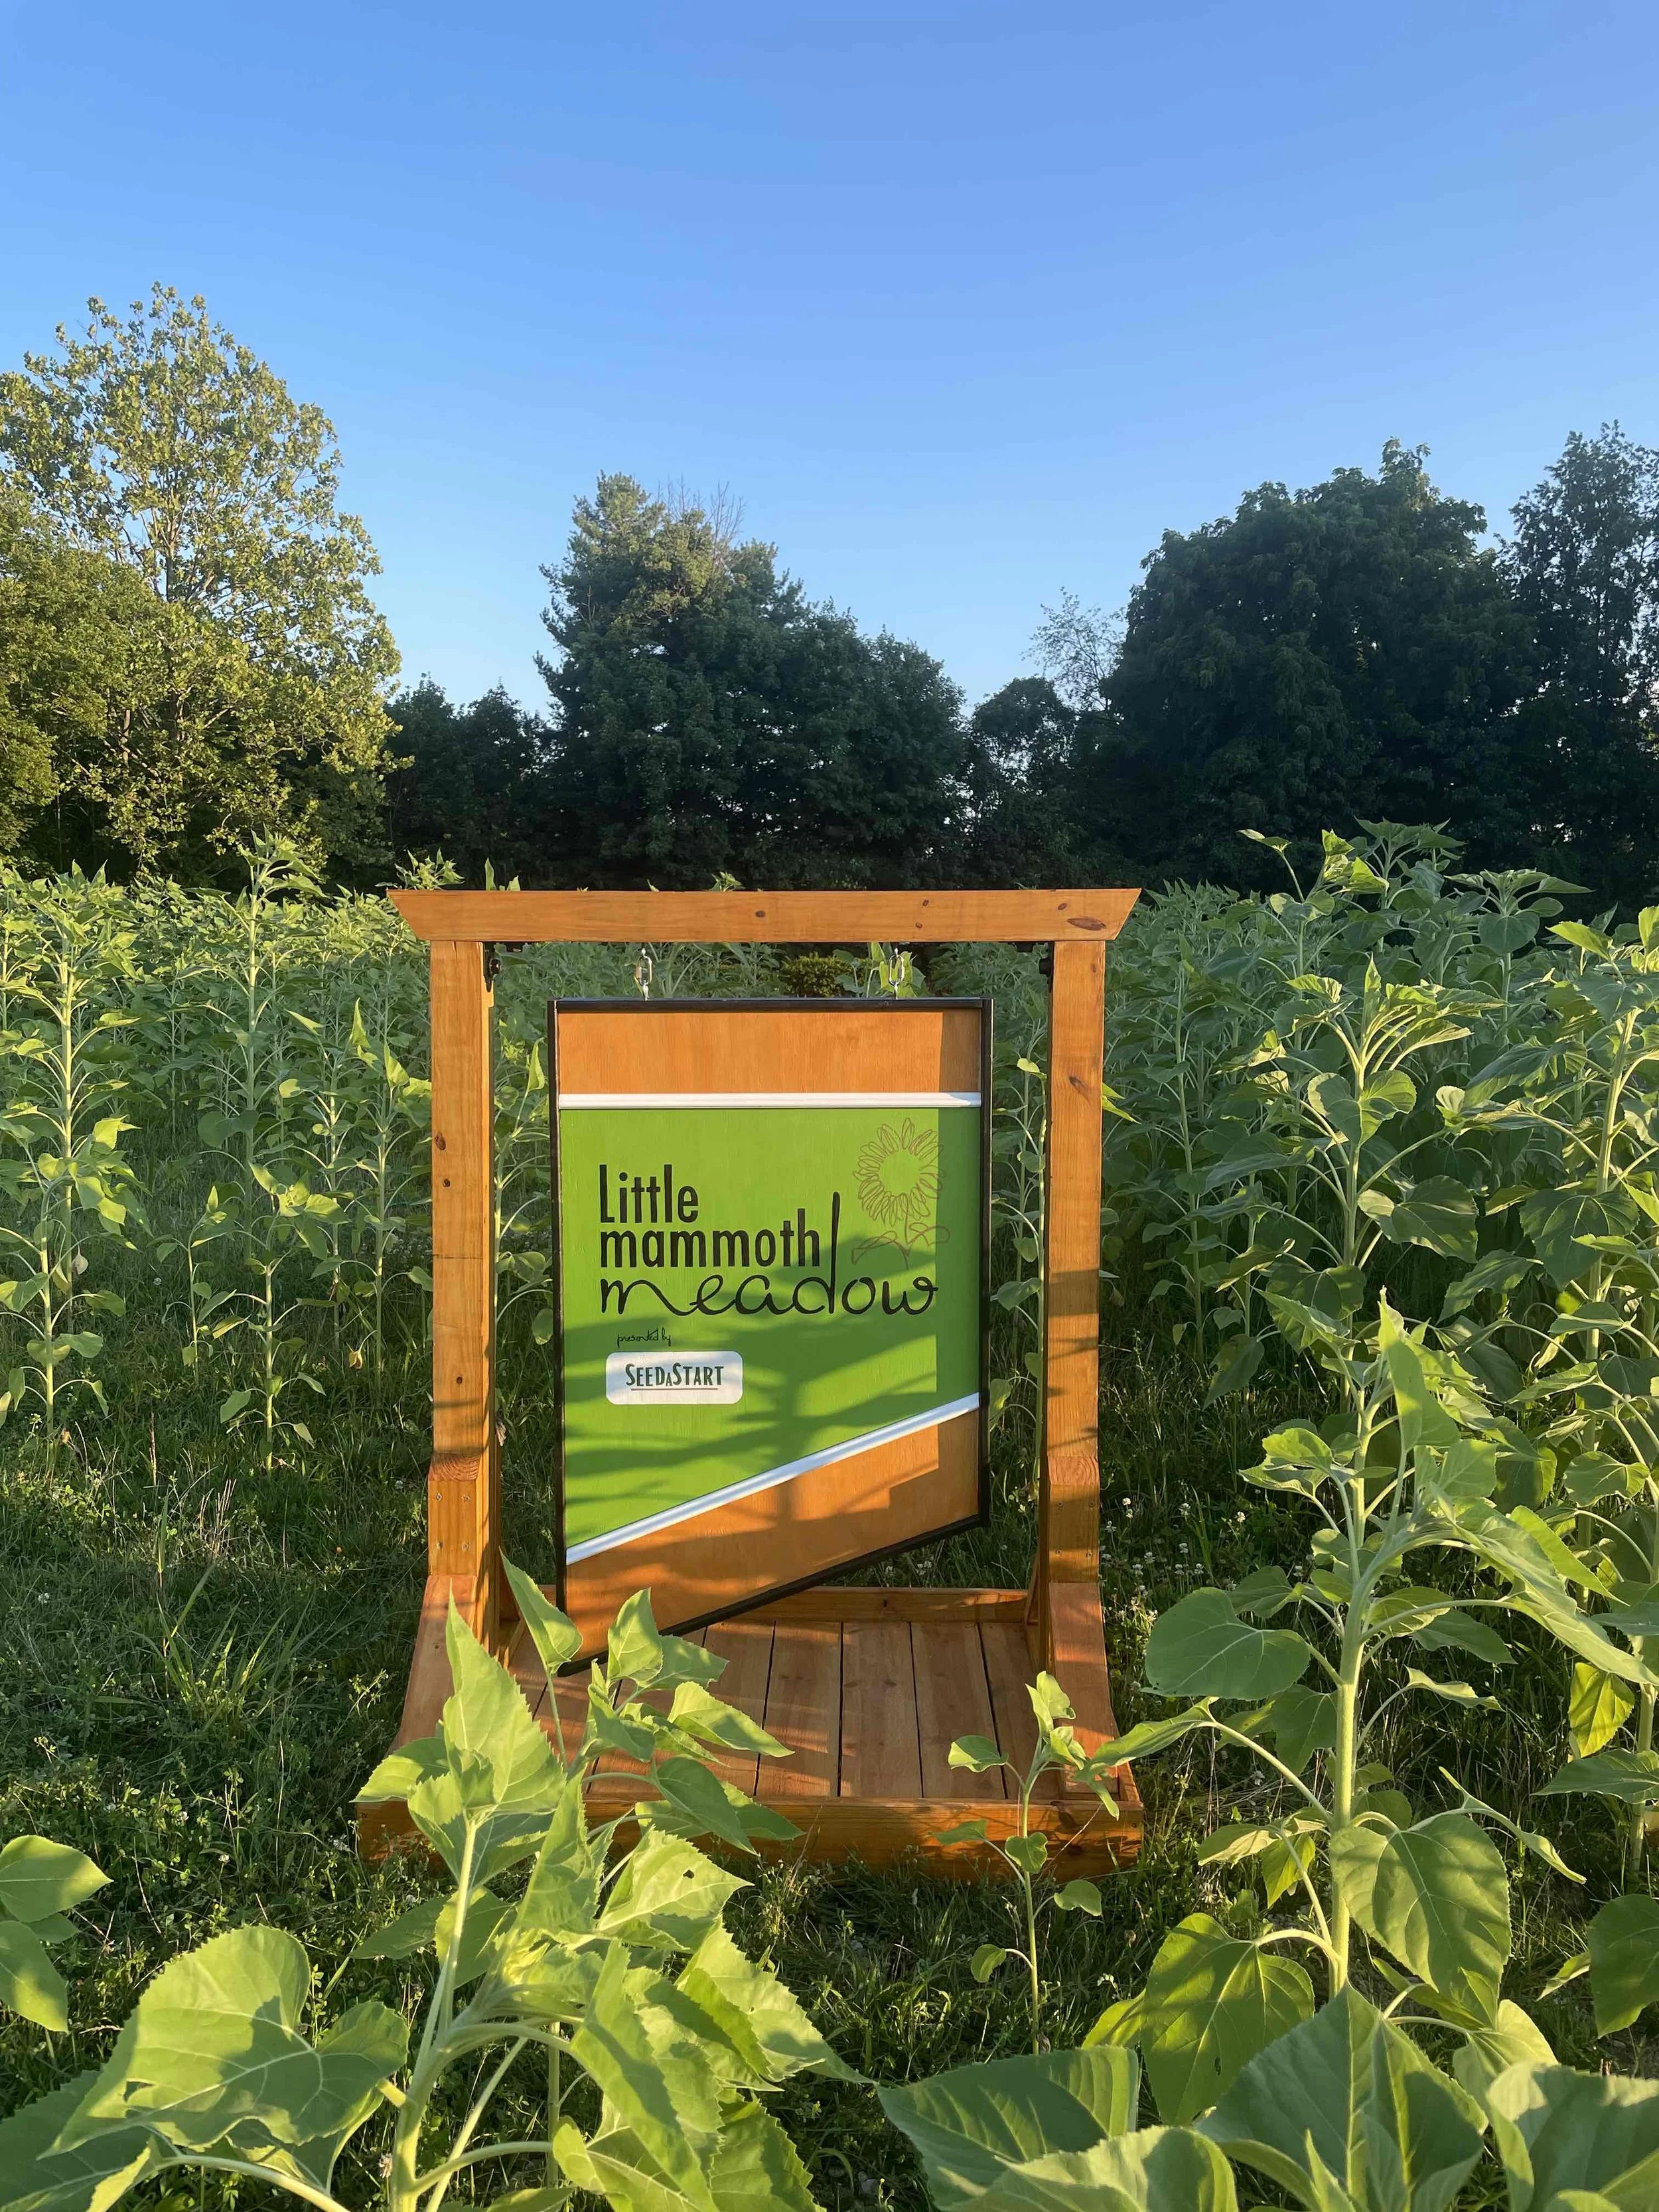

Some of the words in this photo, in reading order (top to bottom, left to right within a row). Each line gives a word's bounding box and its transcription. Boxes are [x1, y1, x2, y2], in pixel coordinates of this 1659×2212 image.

[599, 1164, 699, 1223] Little
[601, 1208, 820, 1268] mammoth
[601, 1192, 938, 1316] meadow
[617, 1328, 659, 1348] presented
[662, 1327, 672, 1347] by
